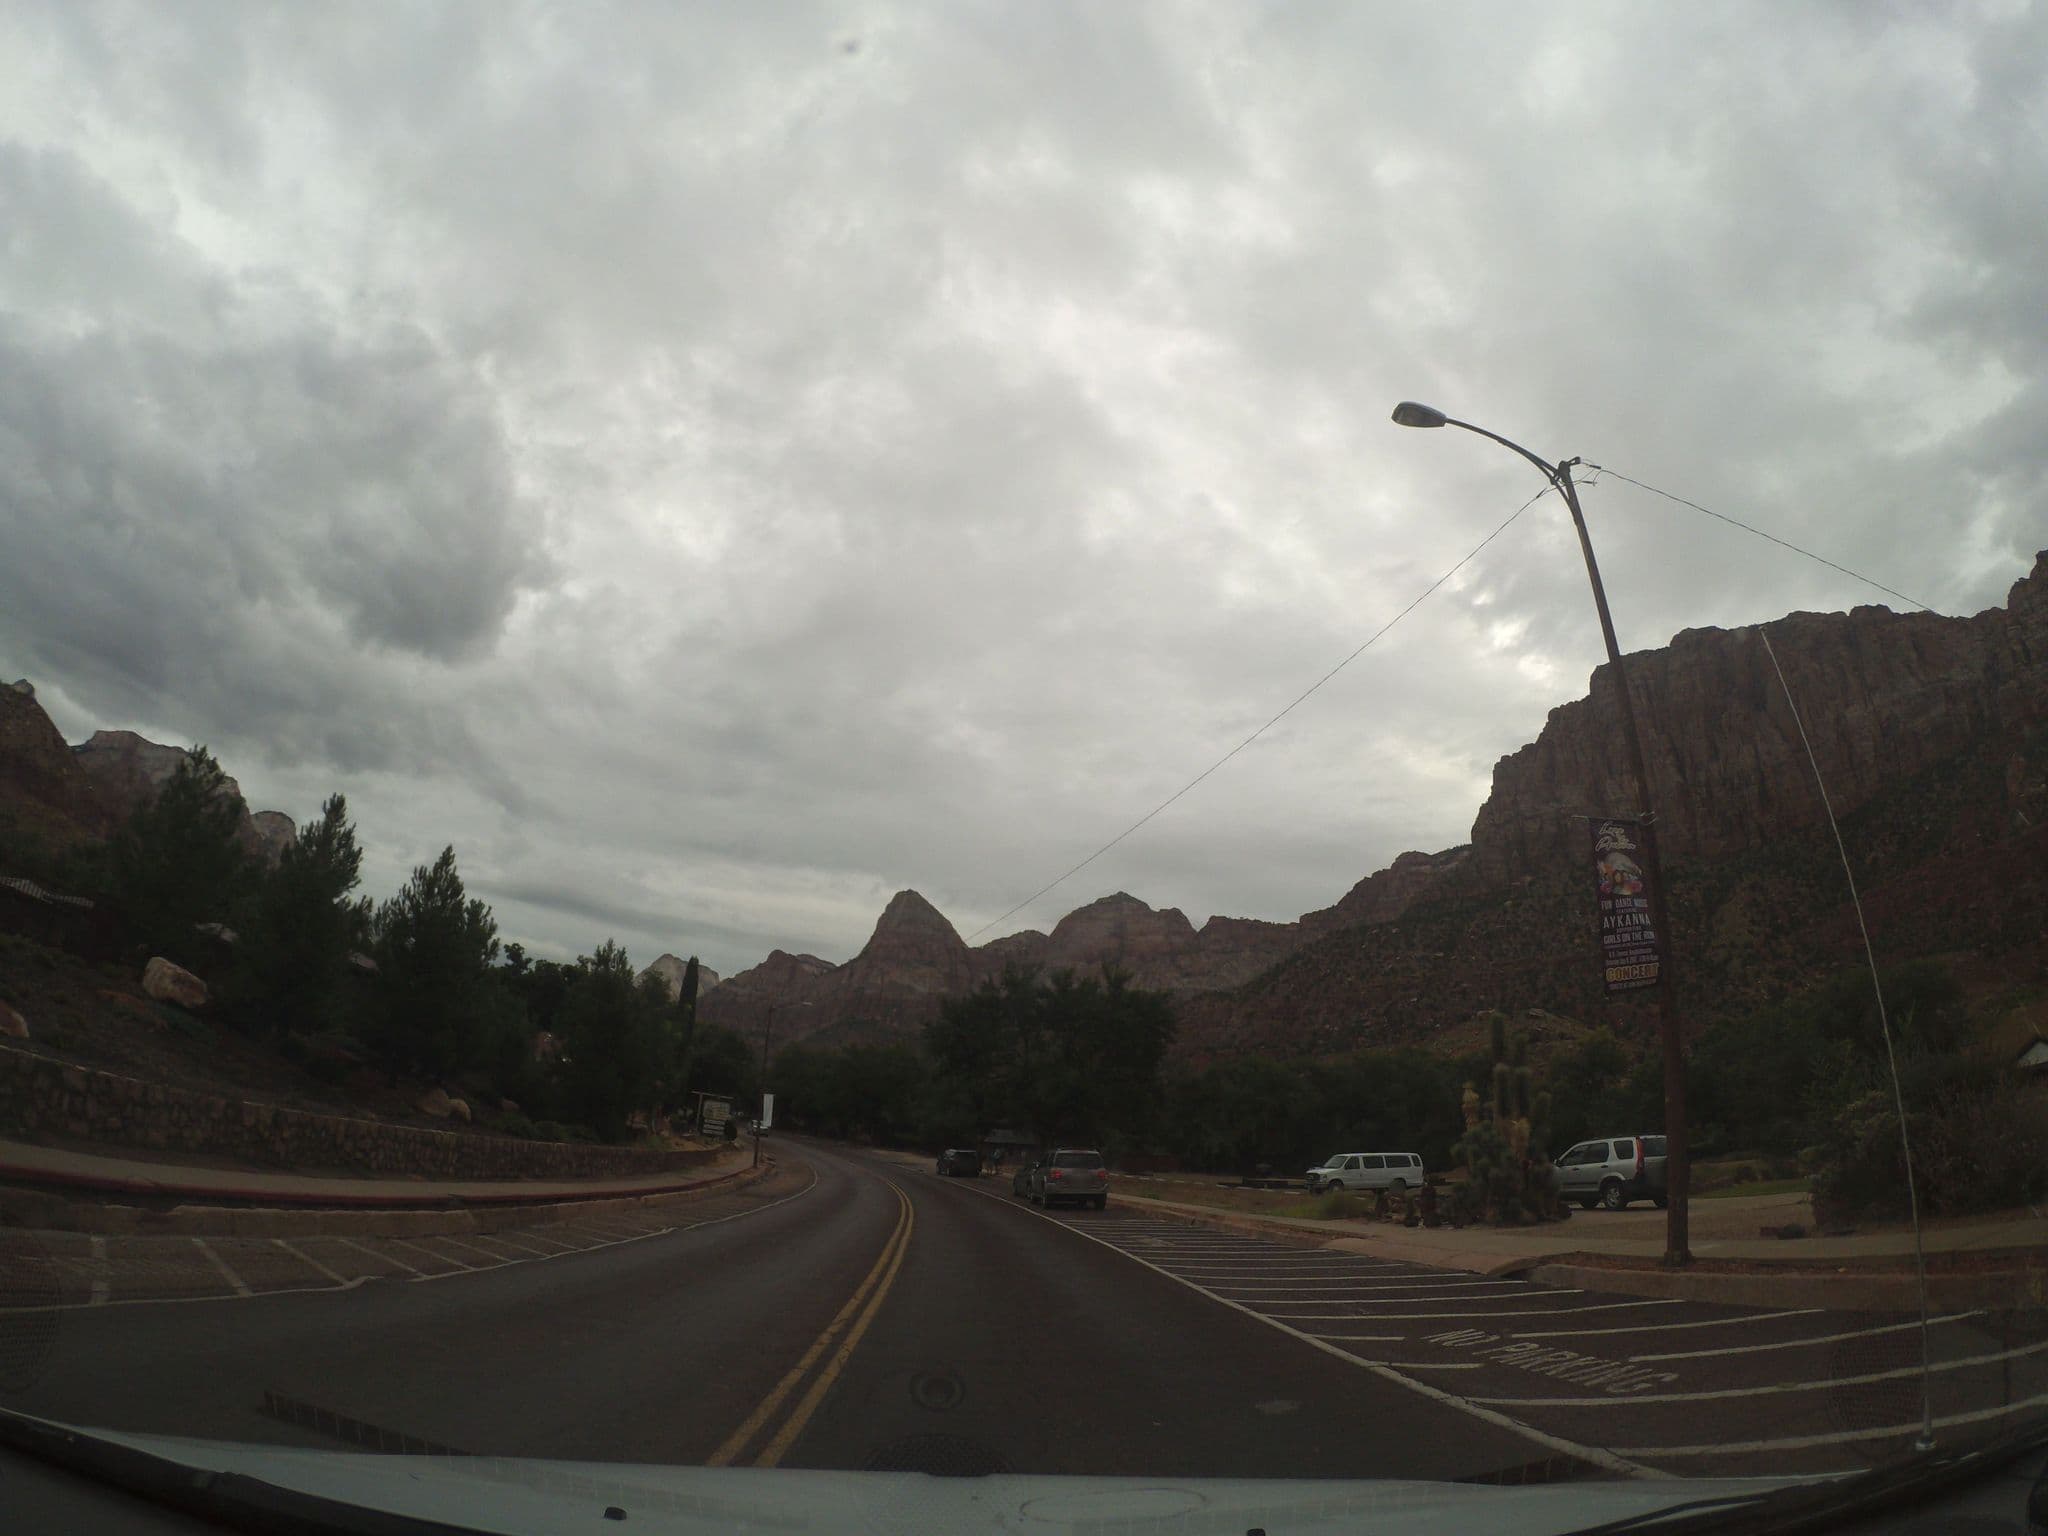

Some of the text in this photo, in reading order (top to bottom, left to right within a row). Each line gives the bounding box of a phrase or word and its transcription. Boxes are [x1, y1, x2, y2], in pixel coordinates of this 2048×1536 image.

[1616, 898, 1633, 909] DANCE
[1603, 913, 1651, 929] AYKANNA
[1606, 962, 1659, 983] CONCERT
[1419, 1328, 1680, 1393] NO PARKING
